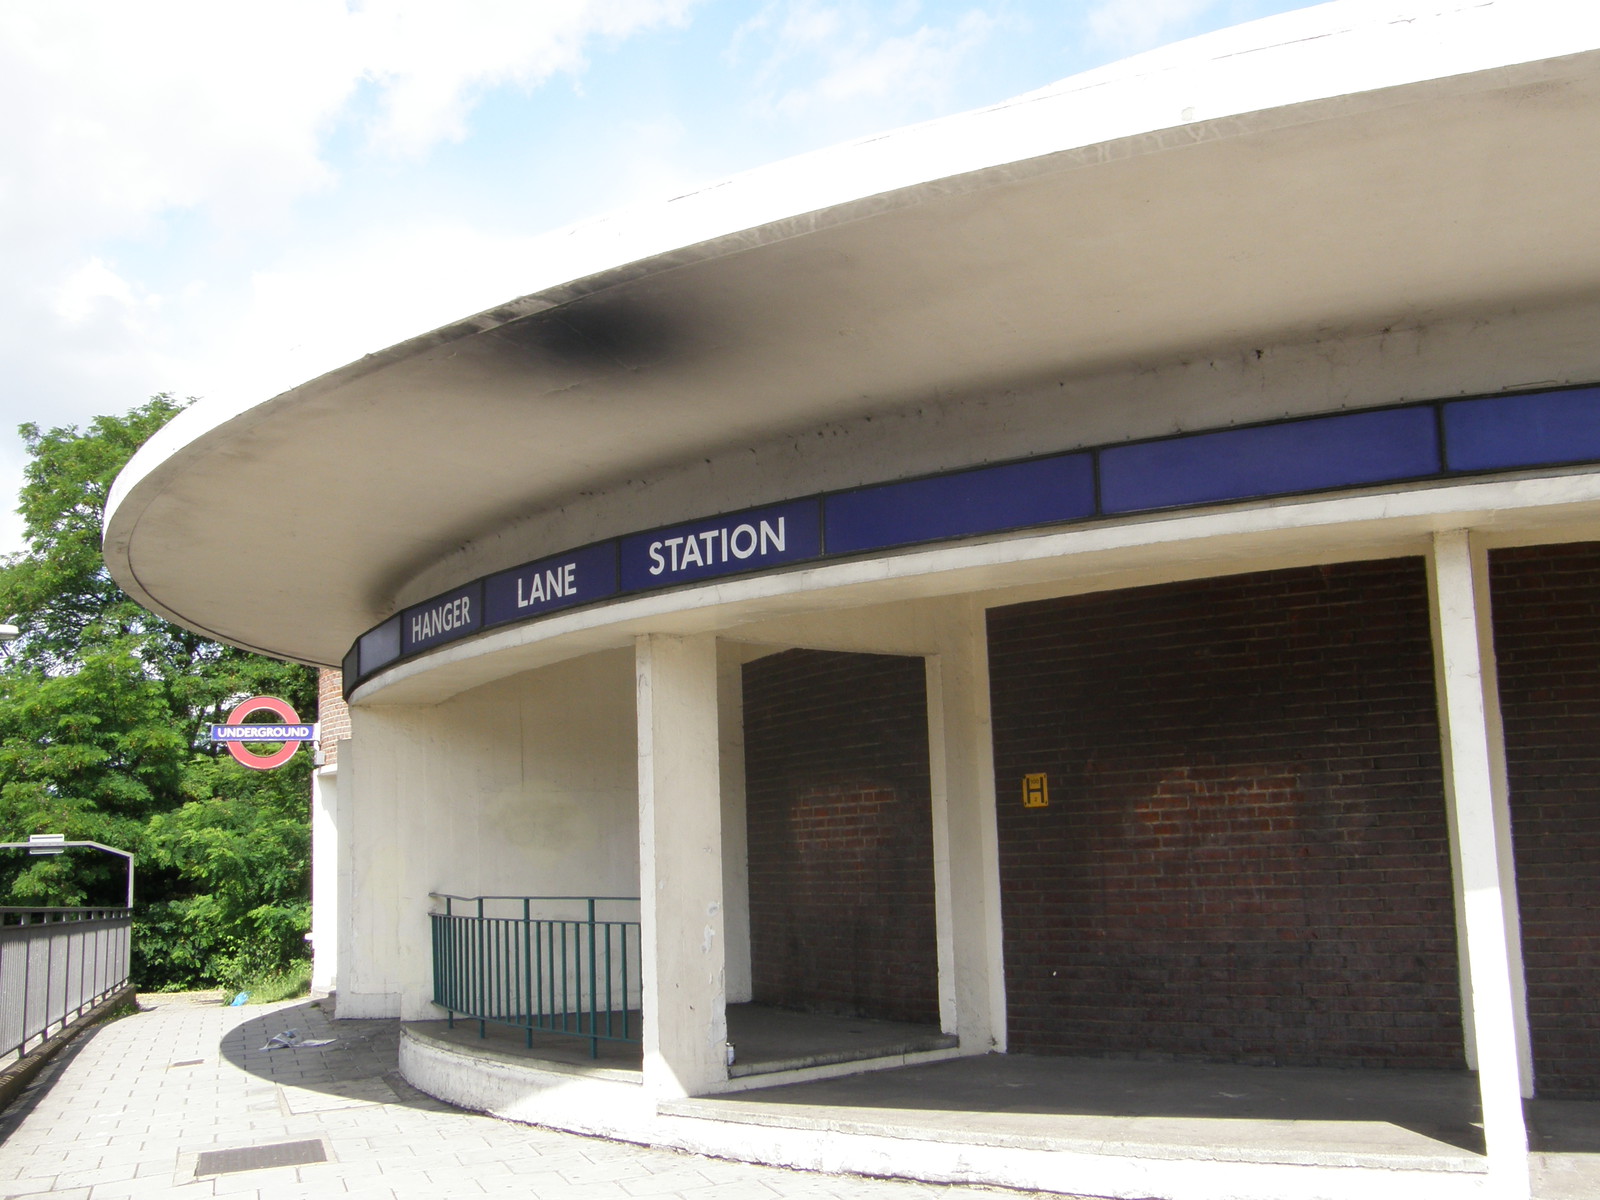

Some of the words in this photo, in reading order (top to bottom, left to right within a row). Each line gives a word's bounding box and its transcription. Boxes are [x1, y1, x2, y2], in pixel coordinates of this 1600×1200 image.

[412, 596, 471, 644] HANGER
[517, 563, 577, 609] LANE
[648, 516, 786, 576] STATION
[217, 727, 309, 738] UNDERGROUND
